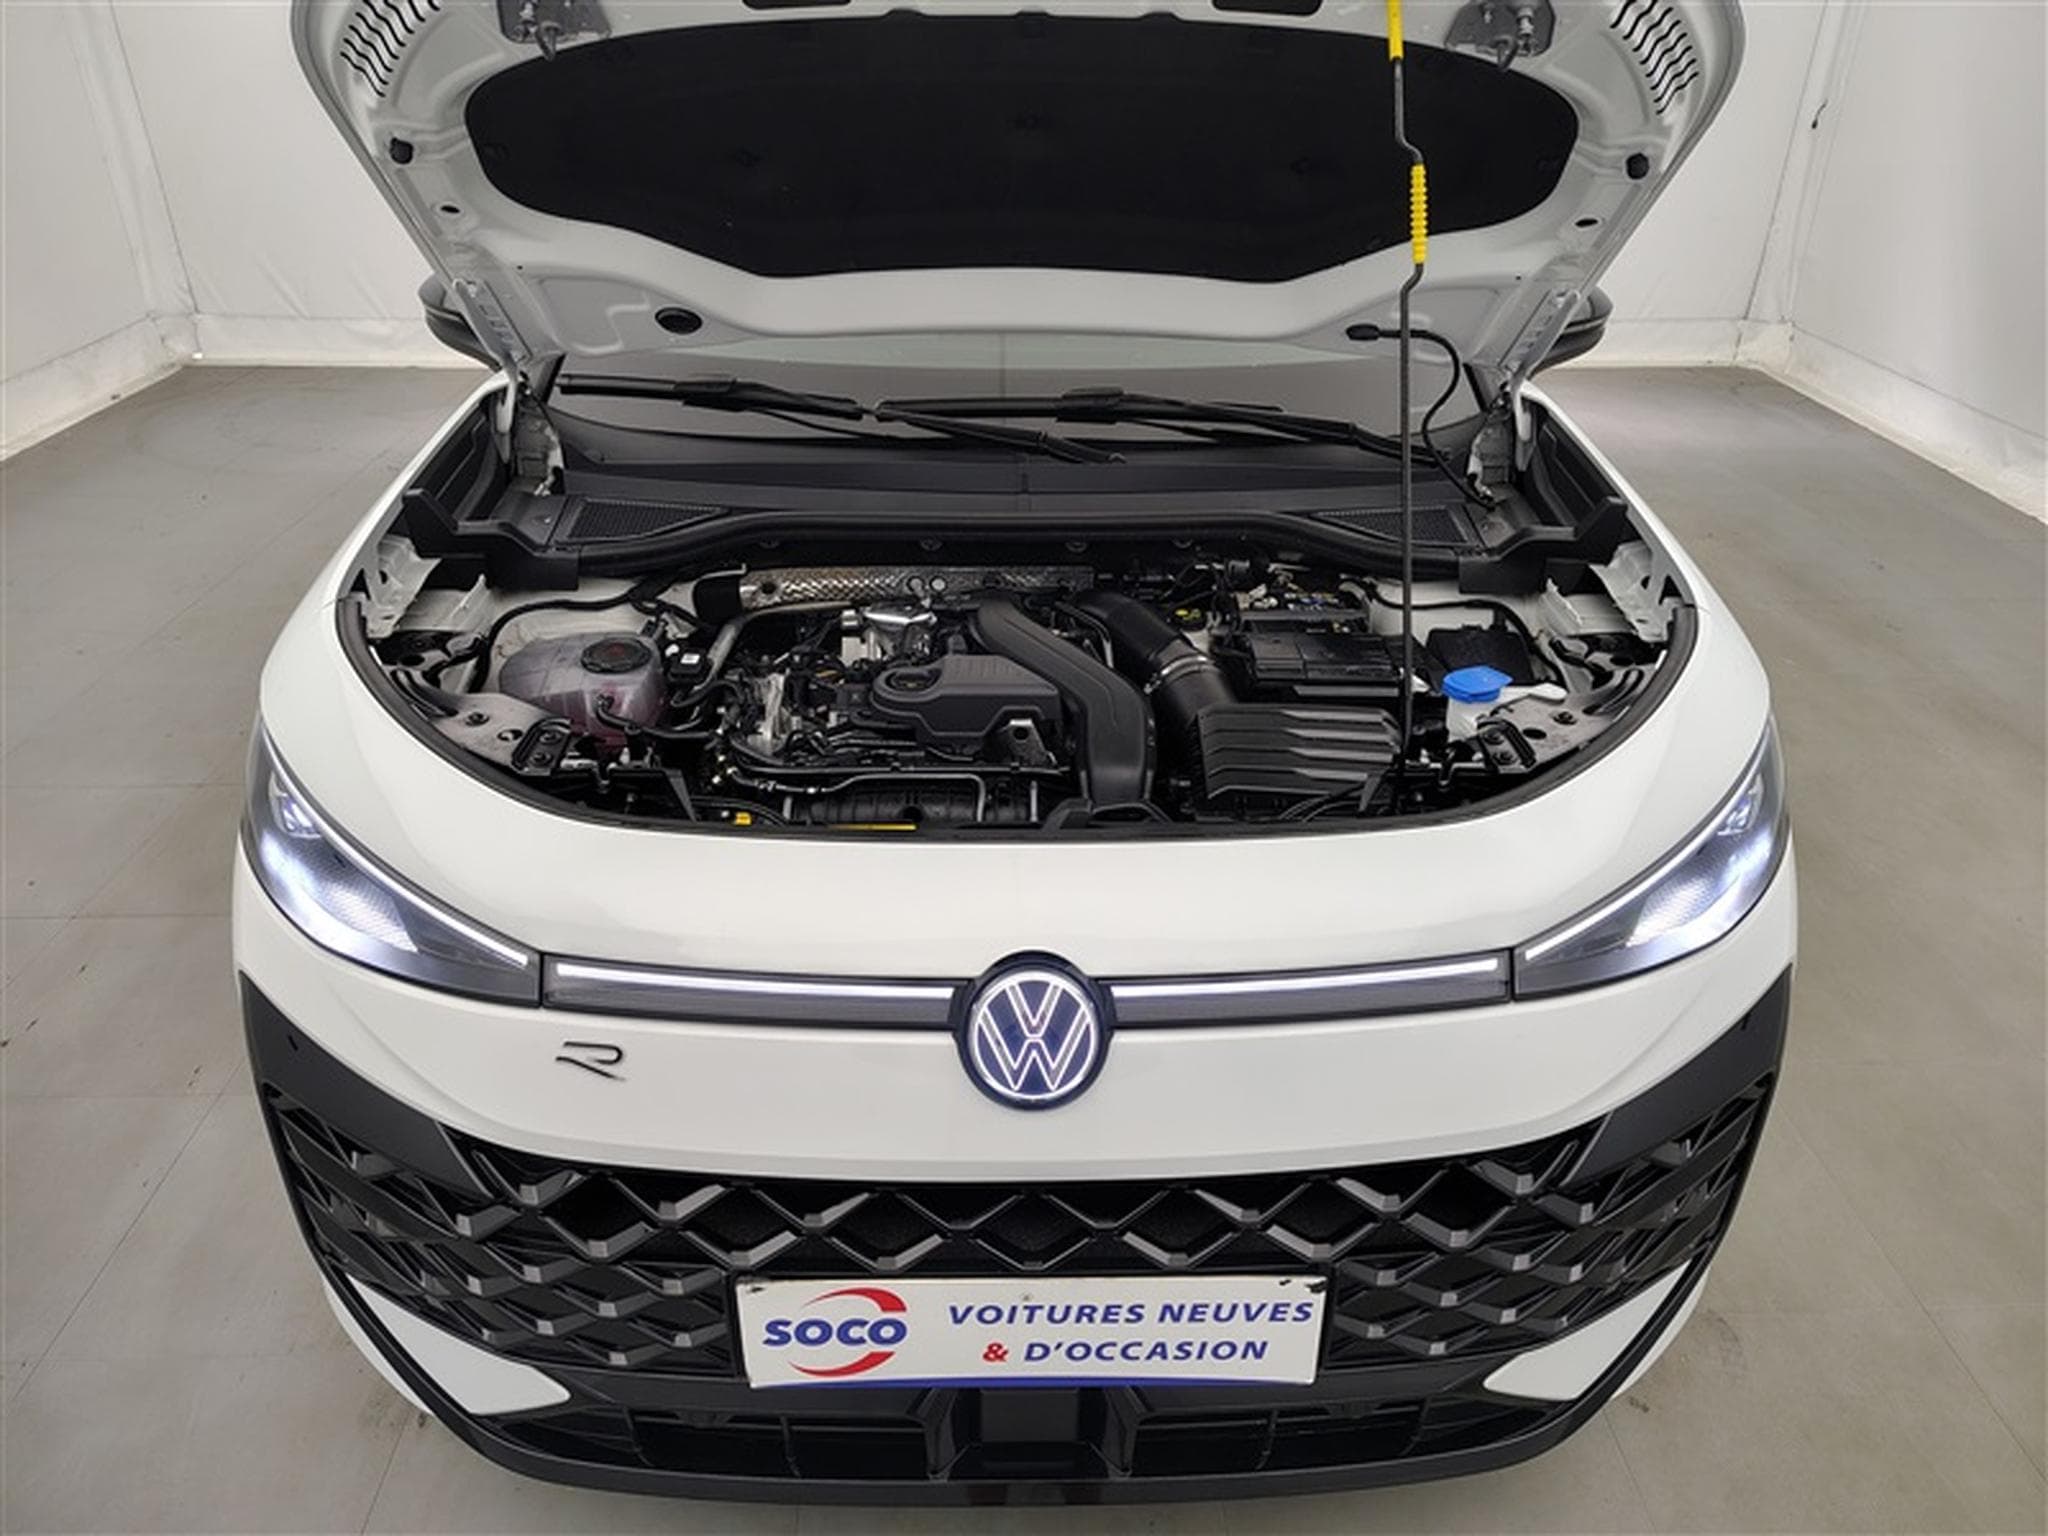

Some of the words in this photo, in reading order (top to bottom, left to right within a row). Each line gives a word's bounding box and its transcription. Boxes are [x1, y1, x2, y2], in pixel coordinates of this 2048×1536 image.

[948, 1303, 1145, 1325] VOITURES
[1157, 1301, 1314, 1324] NEUVES
[762, 1317, 908, 1347] SOCO
[982, 1341, 1009, 1363] &
[1023, 1340, 1268, 1362] D'OCCASION
